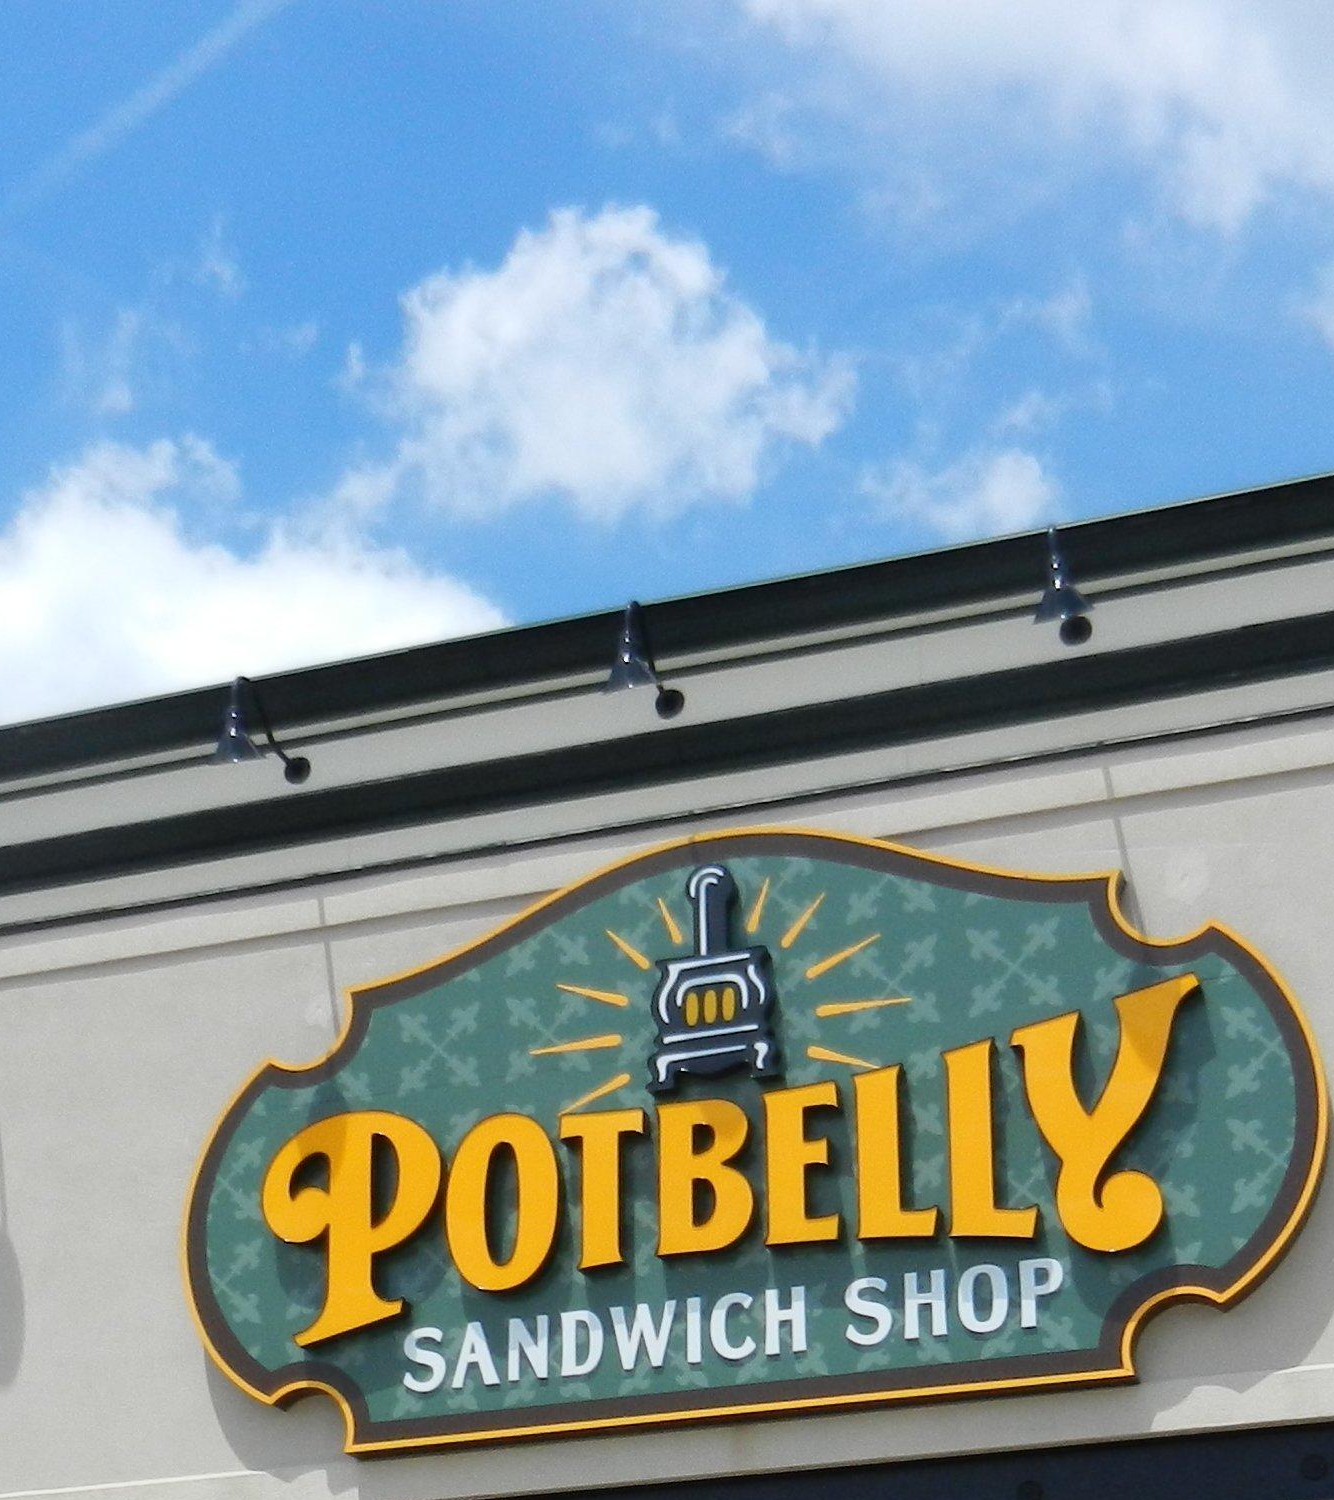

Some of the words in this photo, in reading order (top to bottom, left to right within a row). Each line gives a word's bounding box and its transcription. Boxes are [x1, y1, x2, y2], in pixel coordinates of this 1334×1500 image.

[261, 973, 1201, 1348] POTBELLY
[400, 1290, 809, 1394] SANDWICH
[843, 1258, 1065, 1347] SHOP
